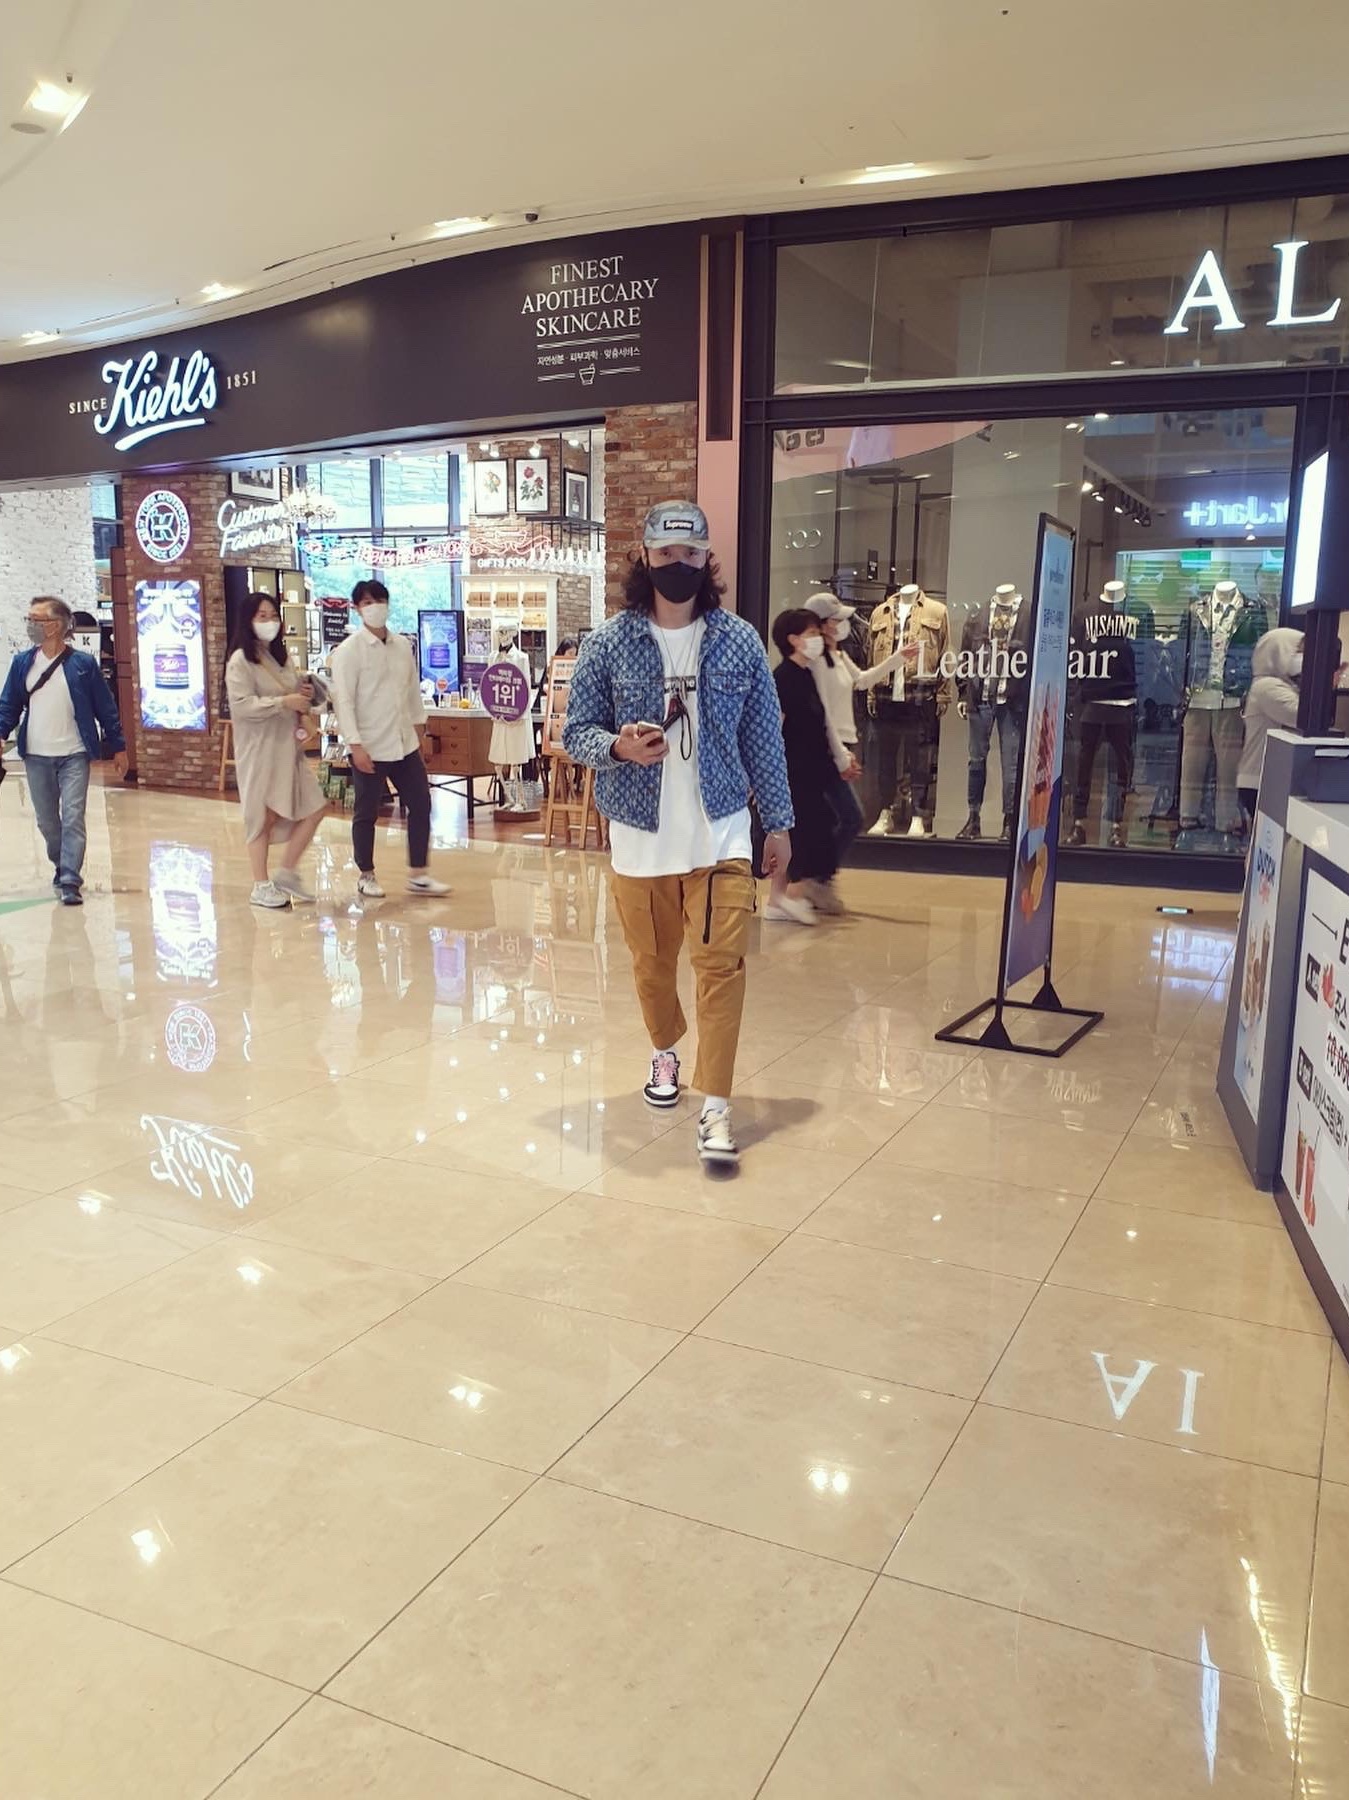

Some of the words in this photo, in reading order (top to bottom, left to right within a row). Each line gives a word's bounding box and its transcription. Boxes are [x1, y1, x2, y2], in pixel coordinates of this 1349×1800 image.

[550, 255, 624, 285] FINEST
[521, 278, 659, 315] APOTHECARY
[536, 306, 641, 337] SKINCARE
[537, 353, 565, 366] 자연성분
[570, 349, 598, 362] 피부과학
[604, 346, 641, 359] 맞춤서비스
[68, 397, 108, 415] SINCE
[94, 350, 217, 434] Kiehl's
[226, 370, 257, 389] 1851
[913, 637, 1028, 680] Leathe
[1067, 637, 1119, 680] air
